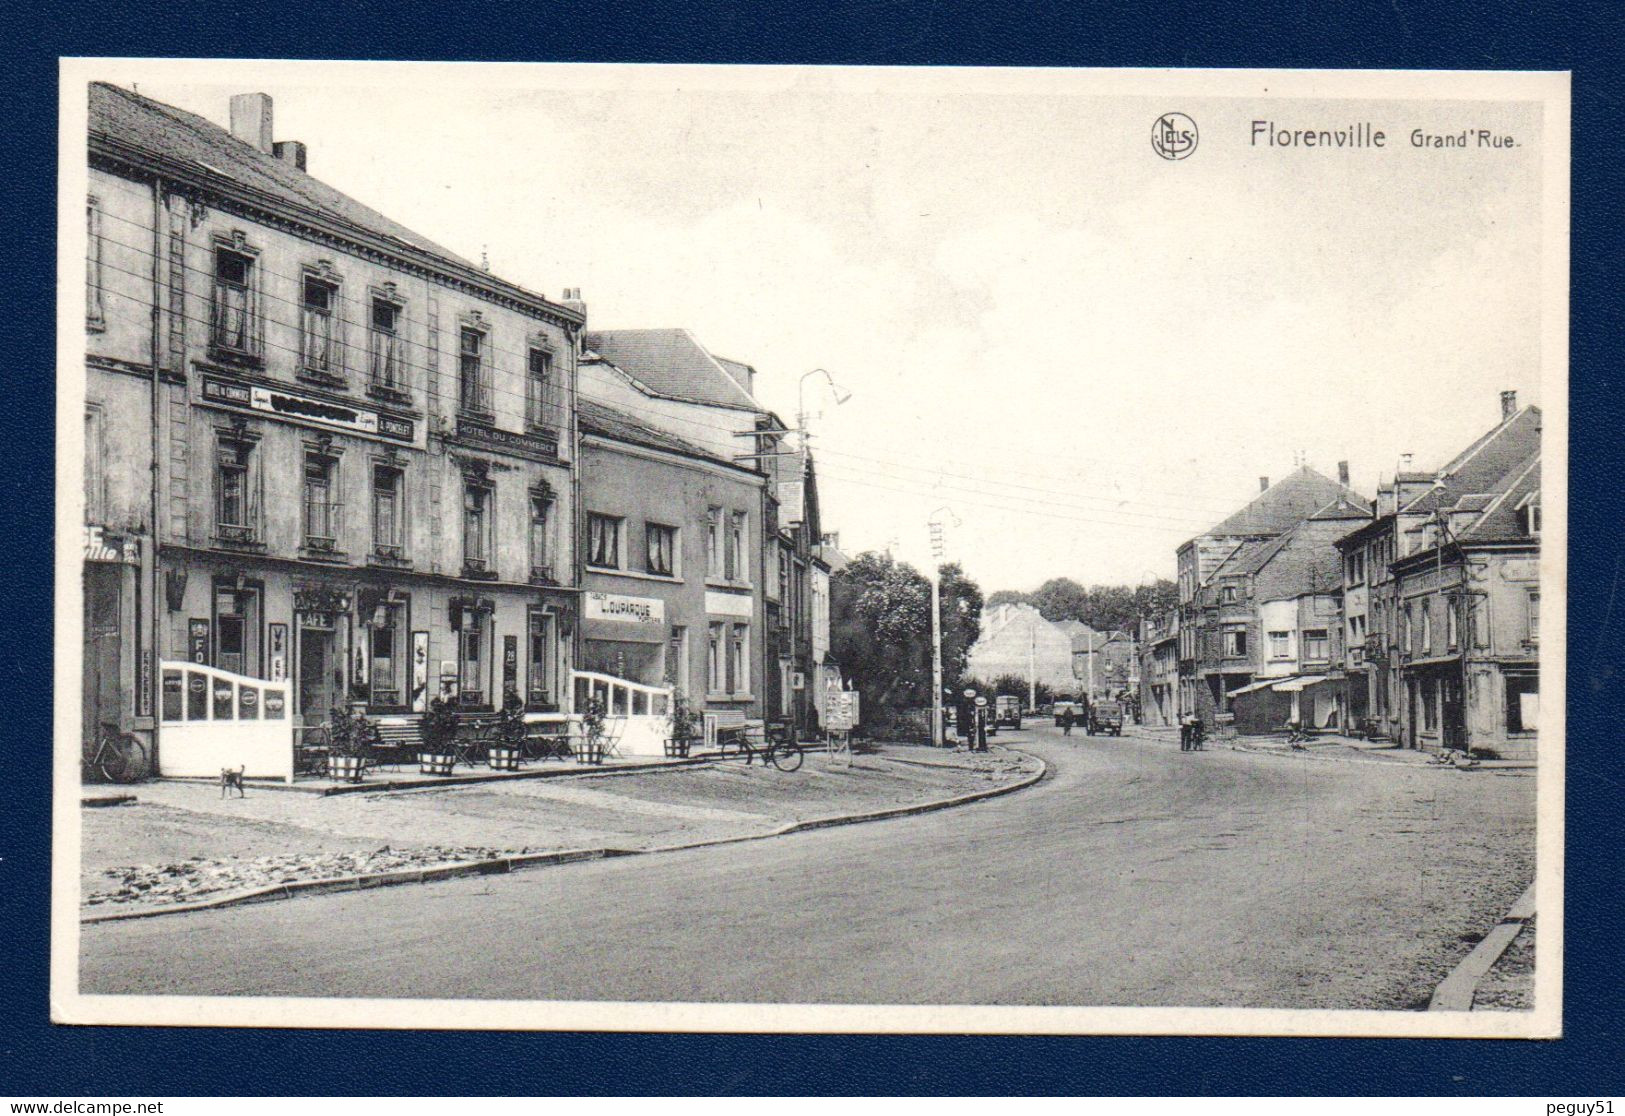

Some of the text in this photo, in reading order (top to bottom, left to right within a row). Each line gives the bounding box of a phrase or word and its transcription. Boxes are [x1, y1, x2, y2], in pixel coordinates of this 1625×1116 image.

[459, 423, 556, 454] HOTEL DU COMMERCE
